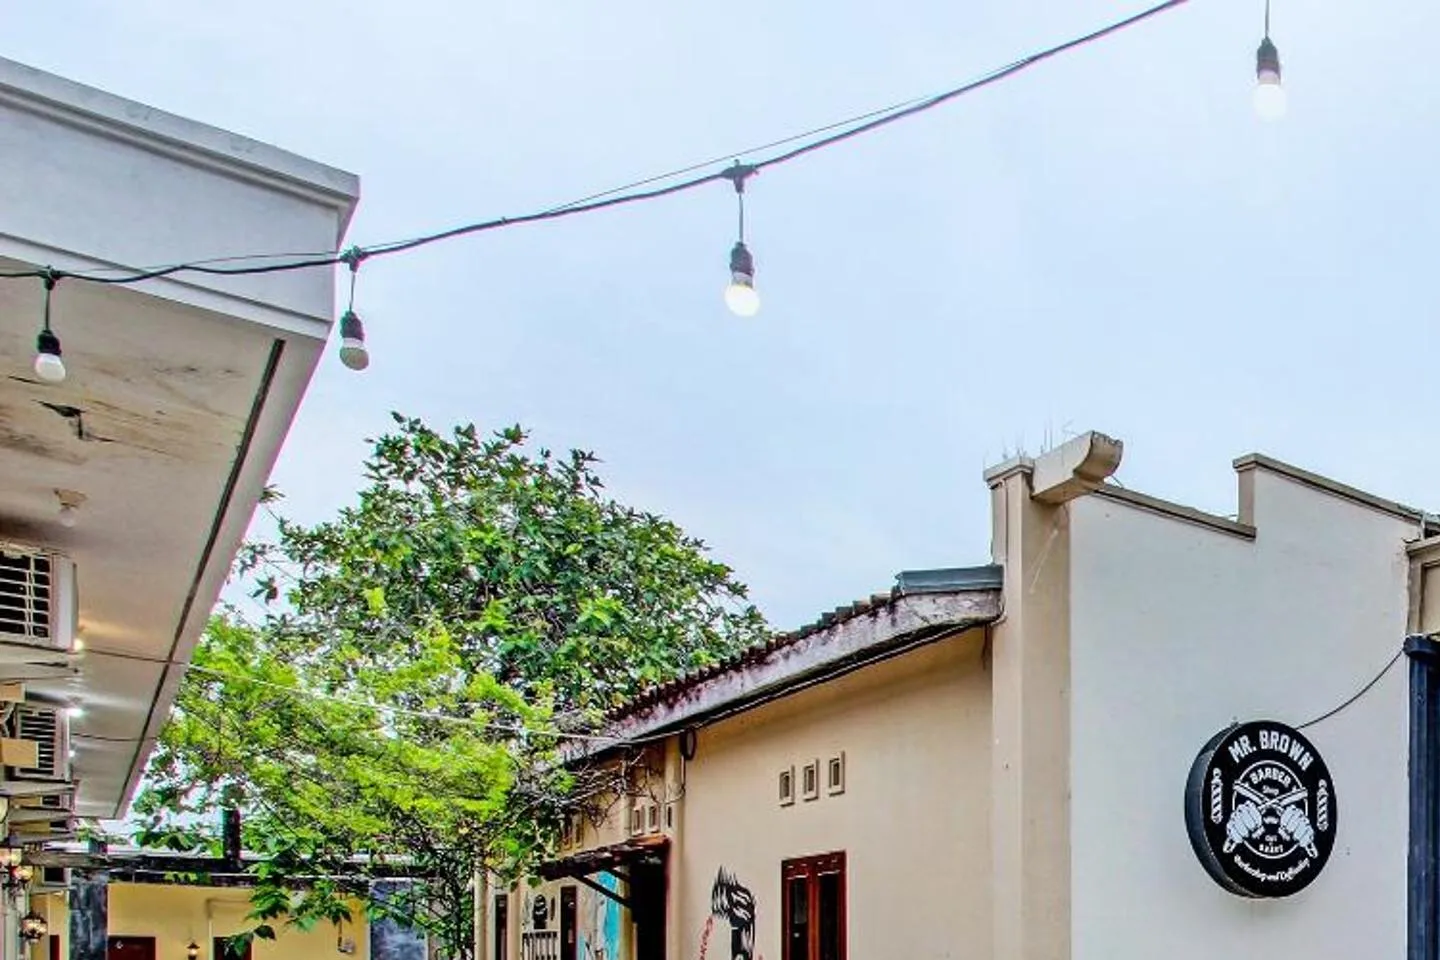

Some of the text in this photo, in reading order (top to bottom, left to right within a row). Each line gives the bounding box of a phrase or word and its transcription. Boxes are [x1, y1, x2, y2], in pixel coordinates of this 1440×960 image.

[1228, 730, 1314, 771] MR. BROWN
[1250, 767, 1291, 788] BARBER
